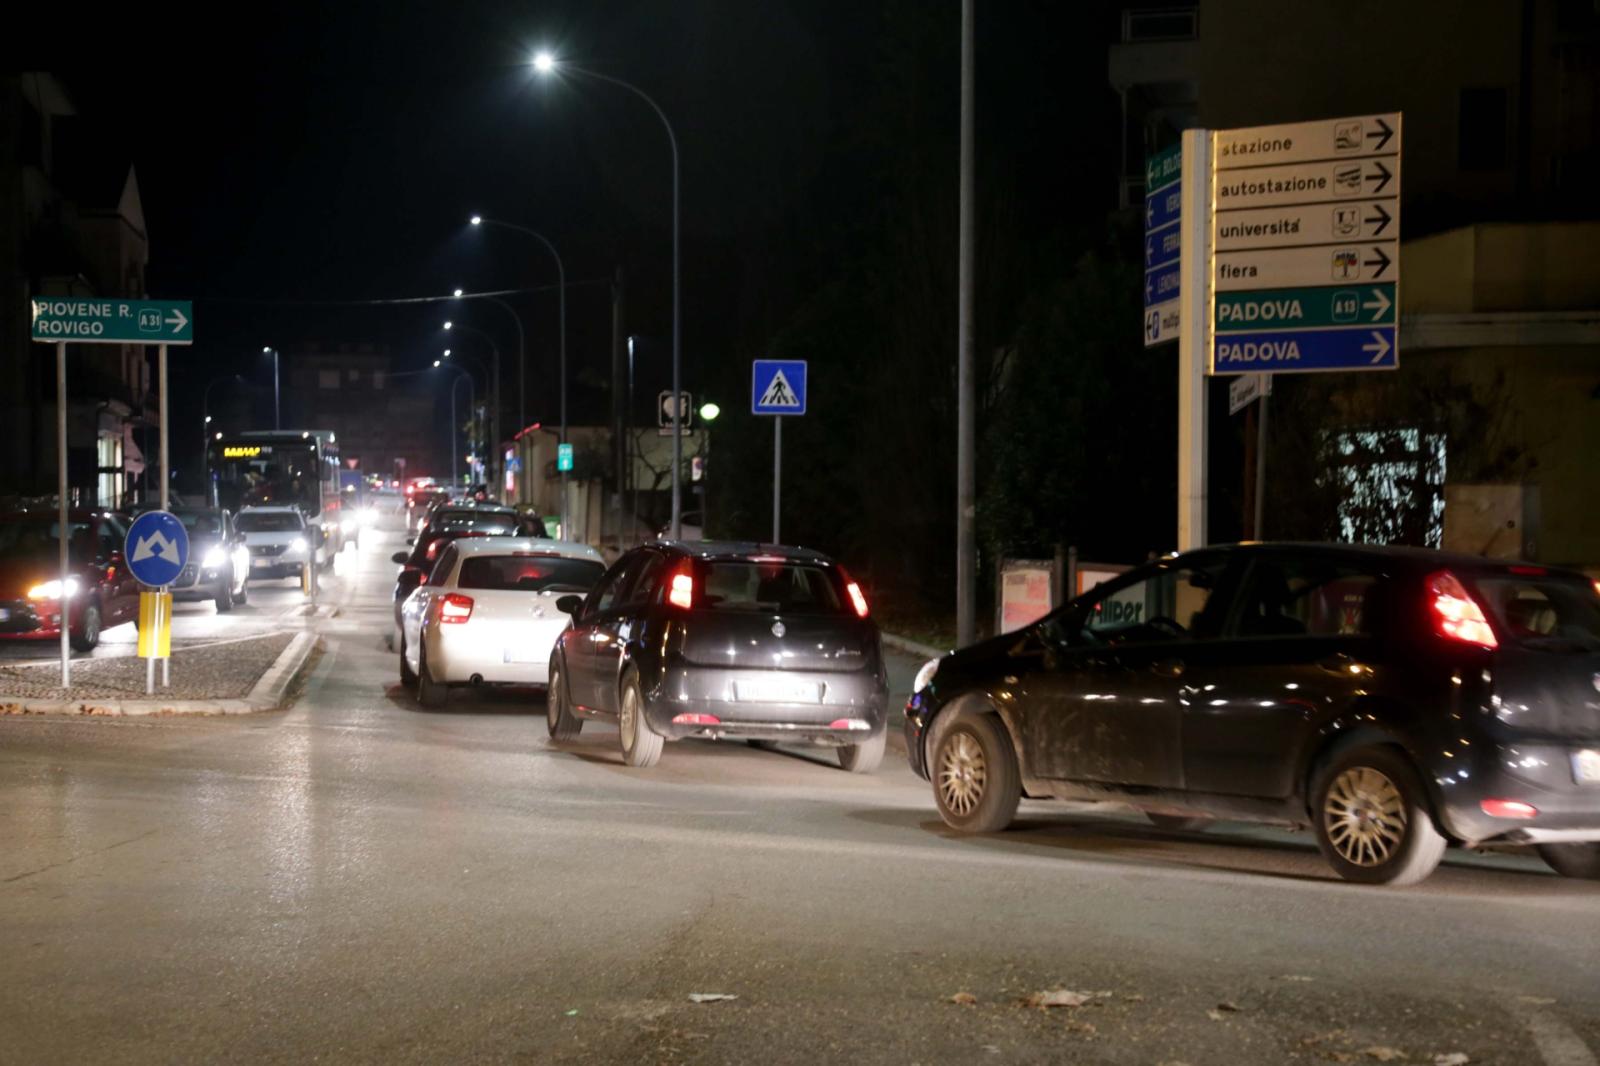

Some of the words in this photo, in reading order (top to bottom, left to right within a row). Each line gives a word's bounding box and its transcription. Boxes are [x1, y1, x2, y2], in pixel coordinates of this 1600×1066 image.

[1222, 138, 1293, 156] stazione
[1221, 176, 1327, 197] autostazione
[1220, 263, 1258, 279] fiera
[38, 302, 112, 317] PIOVENE
[119, 304, 134, 318] R.
[1218, 300, 1303, 322] PADOVA
[38, 320, 104, 335] ROVIGO
[1218, 341, 1300, 362] PADOVA
